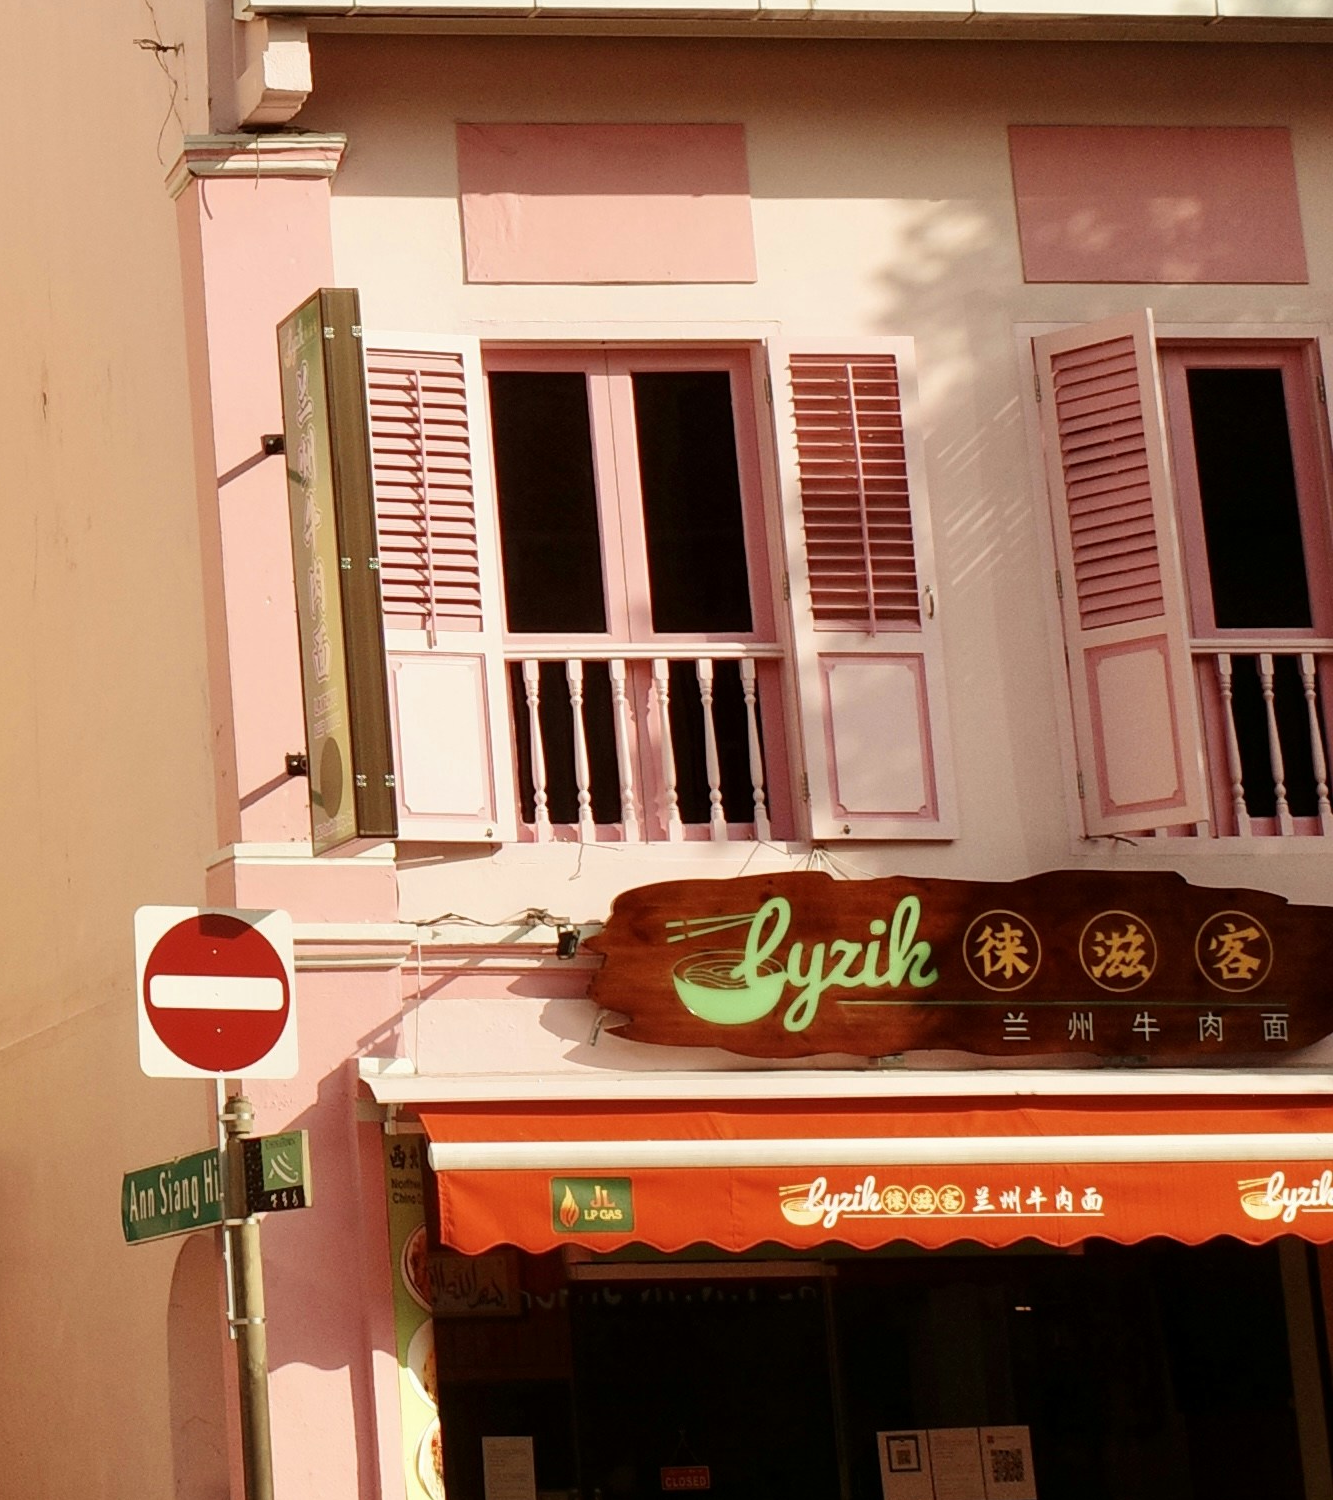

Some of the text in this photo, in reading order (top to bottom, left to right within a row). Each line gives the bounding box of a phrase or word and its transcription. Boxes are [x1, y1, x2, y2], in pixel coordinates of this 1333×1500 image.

[976, 922, 1260, 981] 徕滋客
[1003, 1012, 1289, 1042] 兰州牛肉面
[130, 1158, 223, 1222] Ann Siang Hi
[590, 1185, 615, 1207] JL
[972, 1186, 1104, 1213] 兰州牛肉面
[584, 1209, 623, 1220] LP GAS
[665, 1475, 707, 1487] CLOSED
